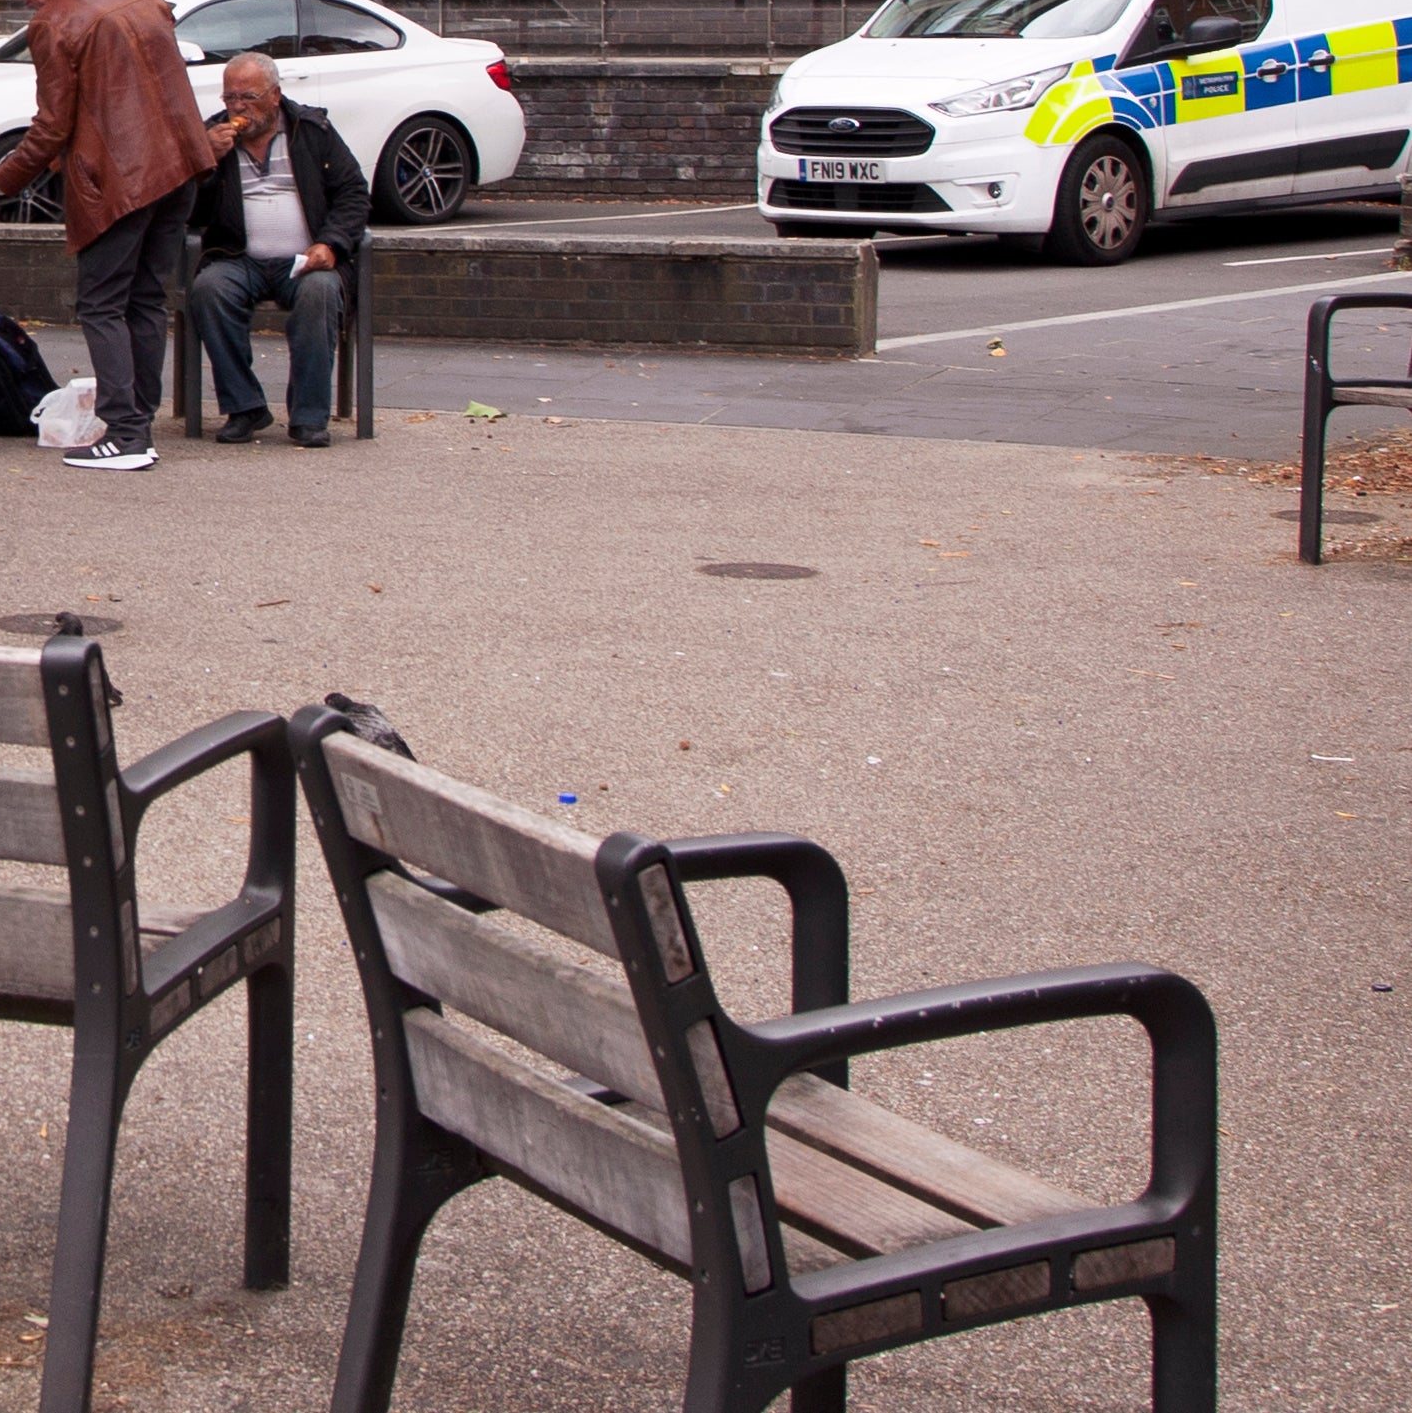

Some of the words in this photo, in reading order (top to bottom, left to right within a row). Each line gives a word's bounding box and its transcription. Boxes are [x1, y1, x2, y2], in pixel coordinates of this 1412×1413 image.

[1204, 84, 1230, 94] POLICE
[811, 161, 845, 180] FN19
[848, 162, 879, 180] WXC
